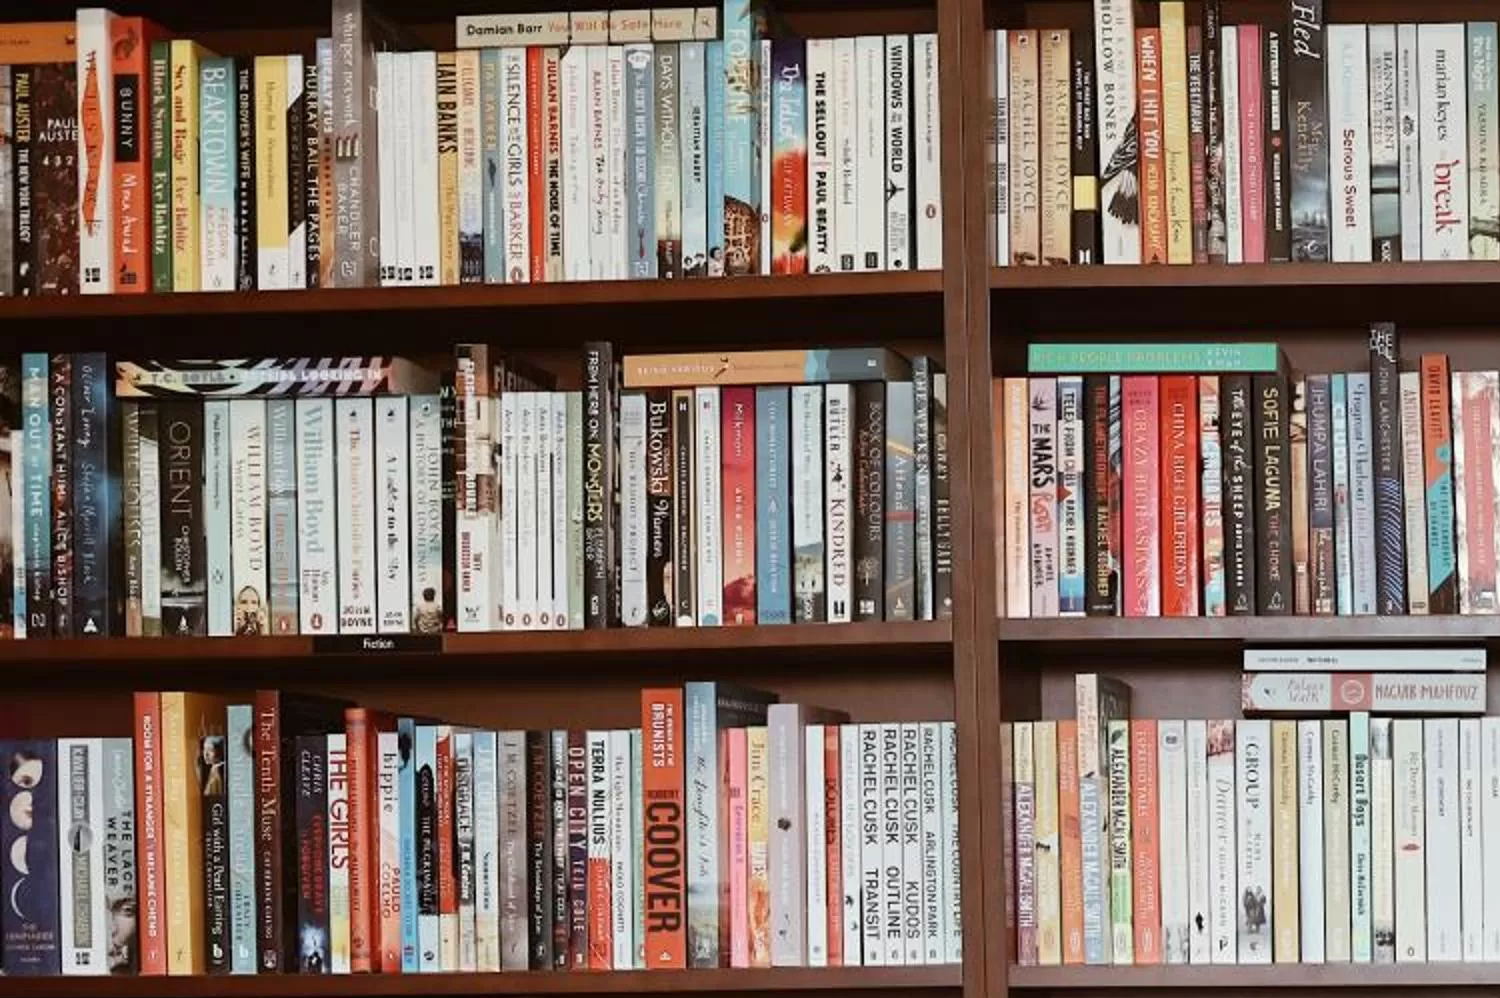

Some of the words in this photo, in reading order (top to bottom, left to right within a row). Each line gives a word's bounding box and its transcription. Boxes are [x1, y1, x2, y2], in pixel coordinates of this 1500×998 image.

[466, 24, 512, 35] Damian
[517, 23, 542, 34] Barr
[1293, 2, 1320, 58] Fled
[813, 72, 826, 96] THE
[1140, 35, 1154, 83] WHEN
[118, 87, 134, 148] BUNNY
[305, 64, 319, 131] MURRAY
[203, 66, 227, 195] BEARTOWN
[438, 102, 457, 153] BANKS
[814, 102, 826, 157] SELLOUT
[1144, 128, 1156, 158] YOU
[305, 137, 317, 176] BAIL
[1343, 128, 1355, 181] Serious
[306, 182, 318, 207] THE
[816, 171, 826, 205] PAUL
[1345, 186, 1356, 228] Sweet
[1435, 159, 1461, 233] break
[307, 213, 320, 261] PAGES
[816, 211, 827, 253] BEATTY
[1264, 388, 1278, 439] SOFIE
[169, 421, 191, 519] ORIENT
[650, 401, 670, 495] Bukowski
[1033, 439, 1053, 488] MARS
[1264, 445, 1280, 511] LAGUNA
[830, 499, 846, 586] KINDRED
[363, 638, 394, 649] Fiction
[331, 744, 348, 790] THE
[381, 752, 398, 814] hippie
[592, 740, 605, 782] TERRA
[884, 729, 897, 802] RACHEL
[331, 797, 349, 869] GIRLS
[592, 787, 605, 844] NULLIUS
[885, 804, 899, 845] CUSK
[648, 802, 681, 934] COOVER
[887, 866, 900, 938] OUTLINE
